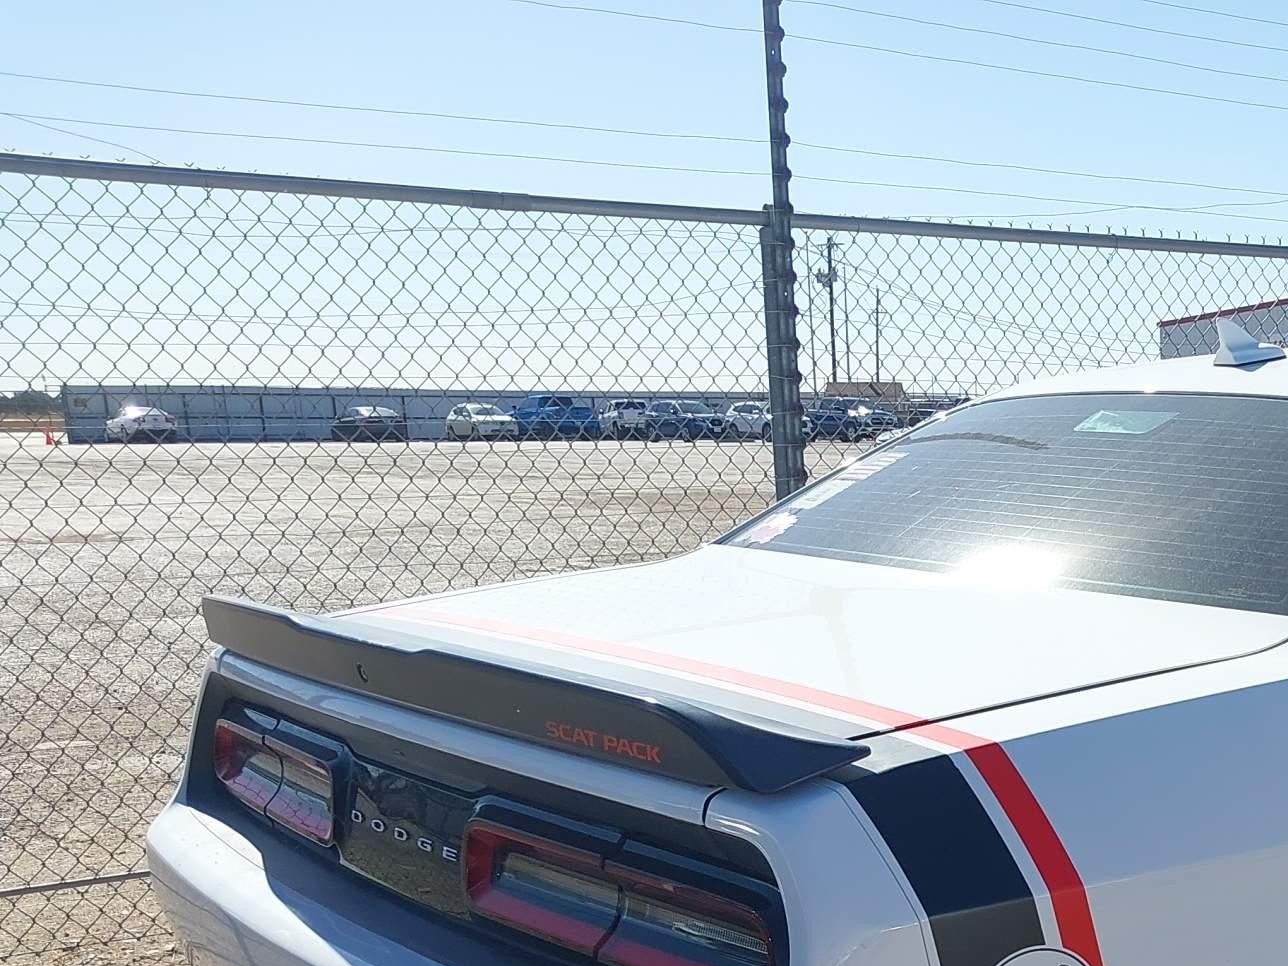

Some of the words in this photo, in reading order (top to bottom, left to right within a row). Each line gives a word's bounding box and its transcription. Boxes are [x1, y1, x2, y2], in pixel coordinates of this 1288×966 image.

[544, 721, 597, 746] SCAT
[603, 735, 661, 763] PACK
[351, 810, 458, 861] DODGE
